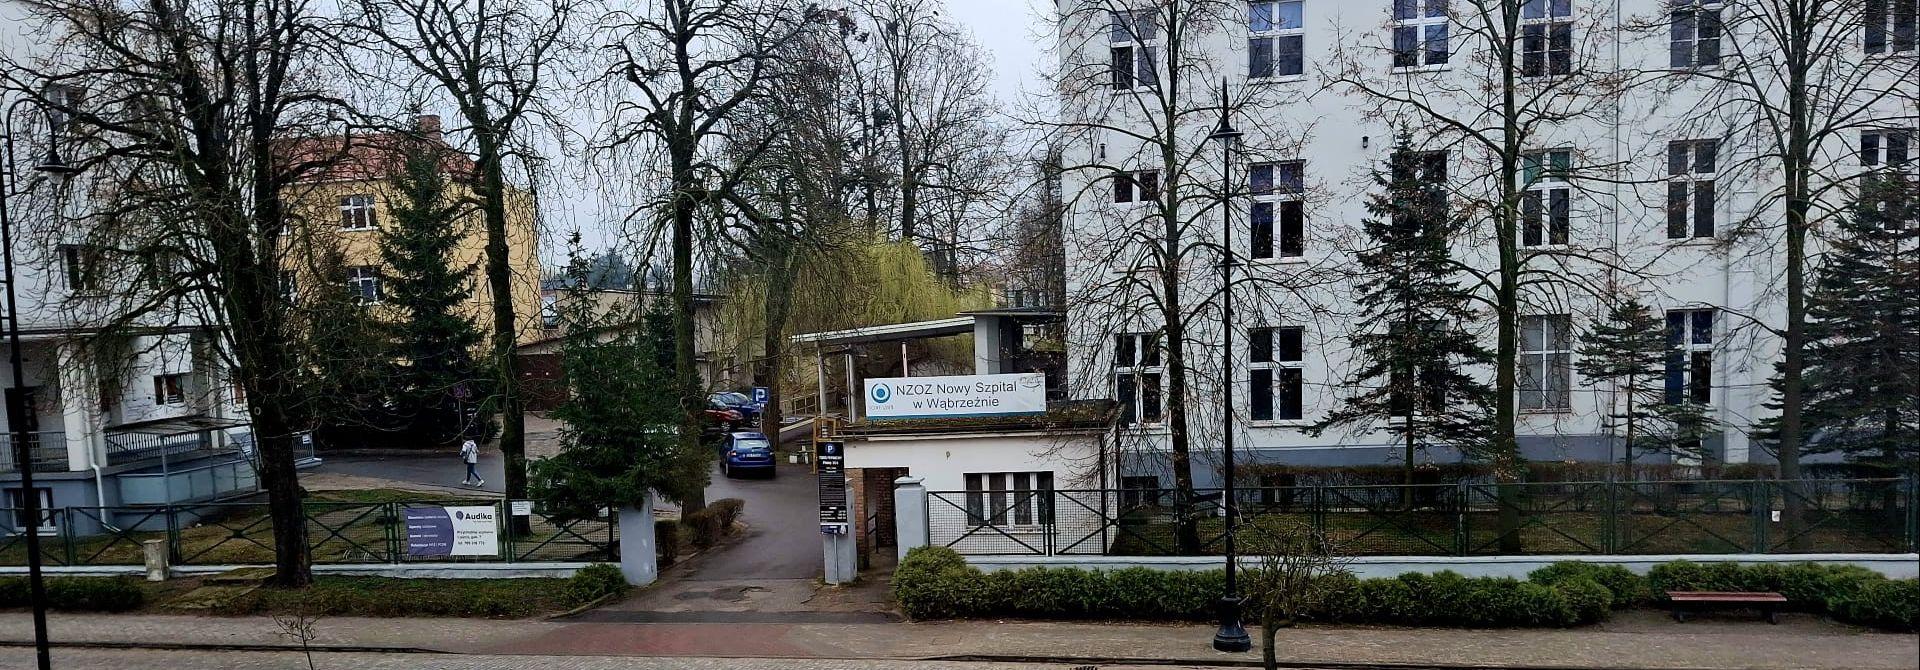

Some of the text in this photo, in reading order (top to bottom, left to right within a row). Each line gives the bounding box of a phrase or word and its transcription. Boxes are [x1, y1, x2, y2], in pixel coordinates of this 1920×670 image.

[755, 388, 766, 402] P
[896, 384, 933, 396] NZOZ
[937, 383, 971, 396] Nowy
[975, 381, 1017, 395] Szpital
[912, 396, 1000, 412] w Wąbrzeźnie
